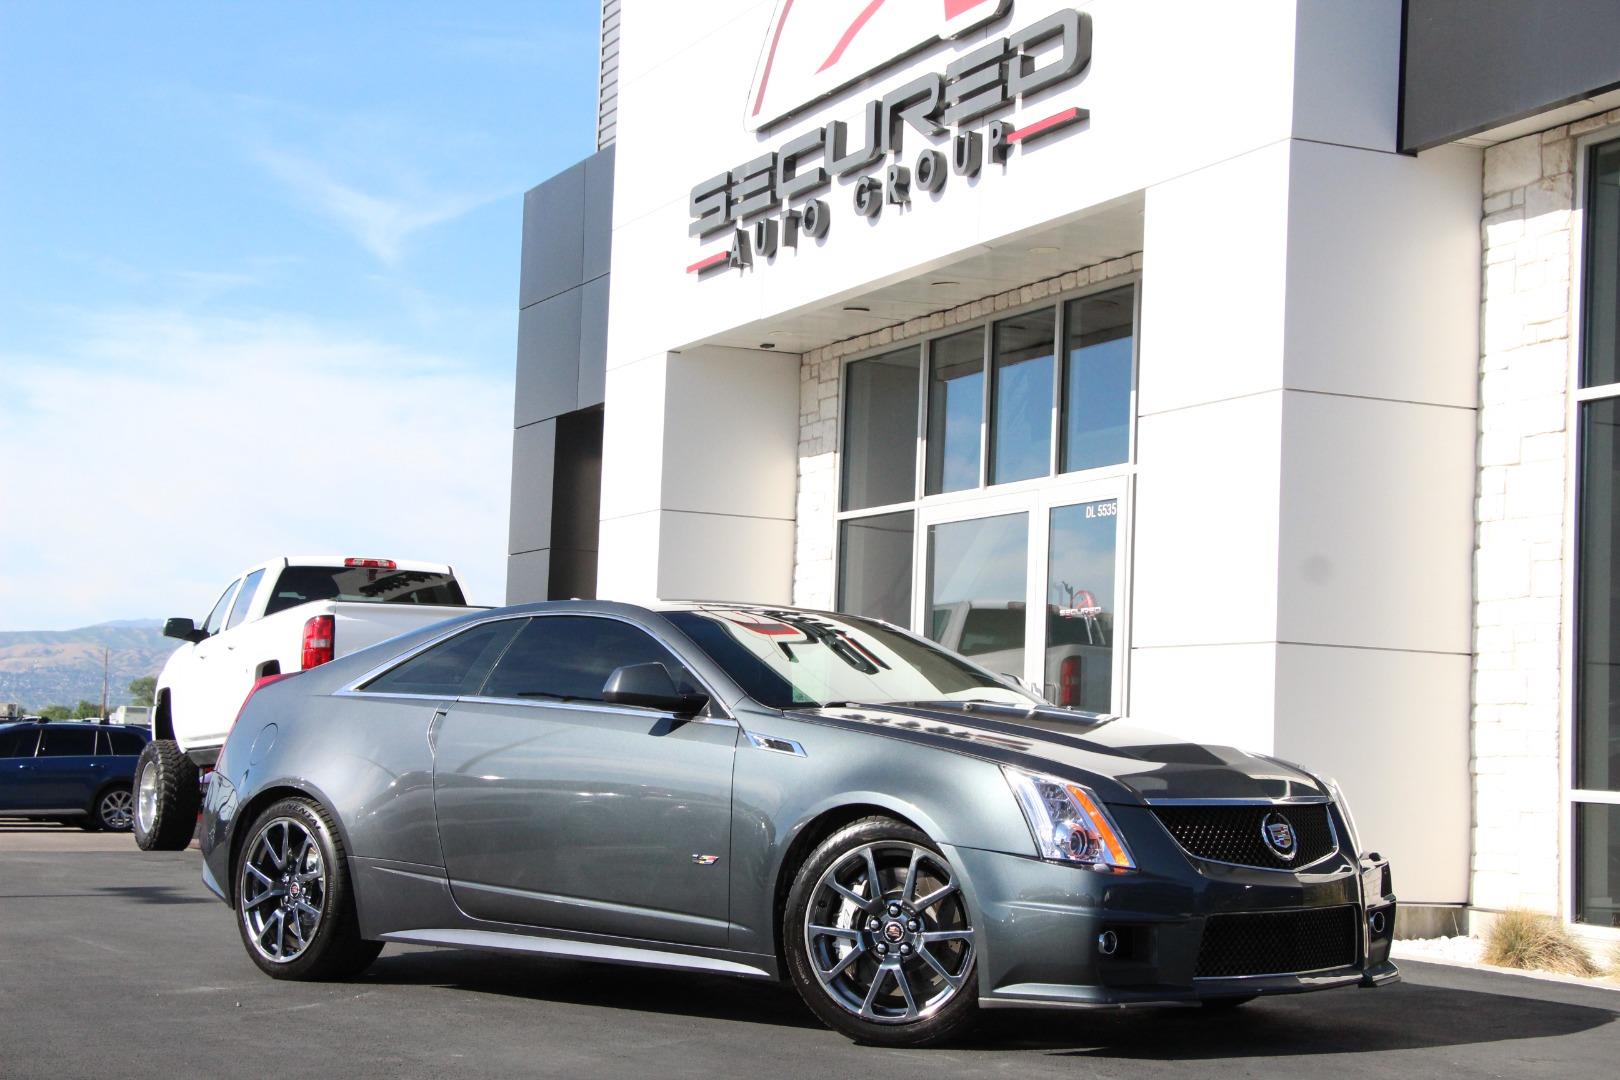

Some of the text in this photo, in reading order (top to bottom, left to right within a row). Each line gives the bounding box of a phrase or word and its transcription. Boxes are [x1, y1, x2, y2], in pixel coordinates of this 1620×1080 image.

[689, 8, 1092, 238] SECURED
[728, 120, 1015, 273] AUTO GROUP
[1085, 502, 1118, 519] DL 5535
